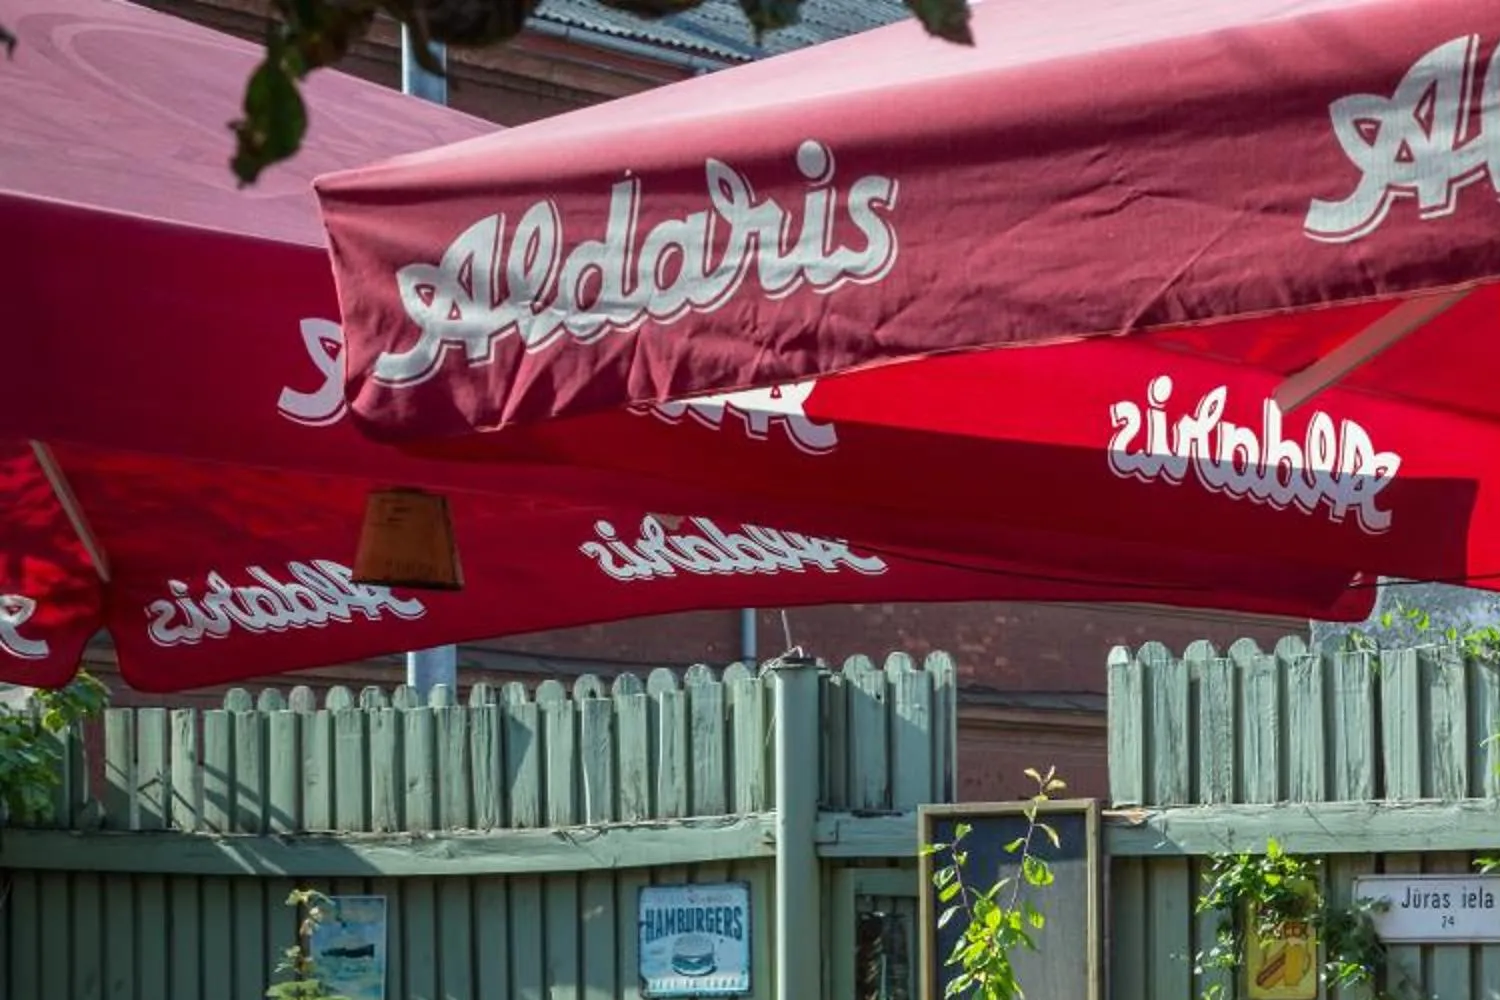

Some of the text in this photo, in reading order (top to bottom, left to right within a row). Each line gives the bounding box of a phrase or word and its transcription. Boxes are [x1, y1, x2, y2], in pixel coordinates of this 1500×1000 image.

[371, 139, 900, 388] Aldaris
[1401, 885, 1494, 909] Jūras iela
[644, 906, 744, 944] HAMBURGERS
